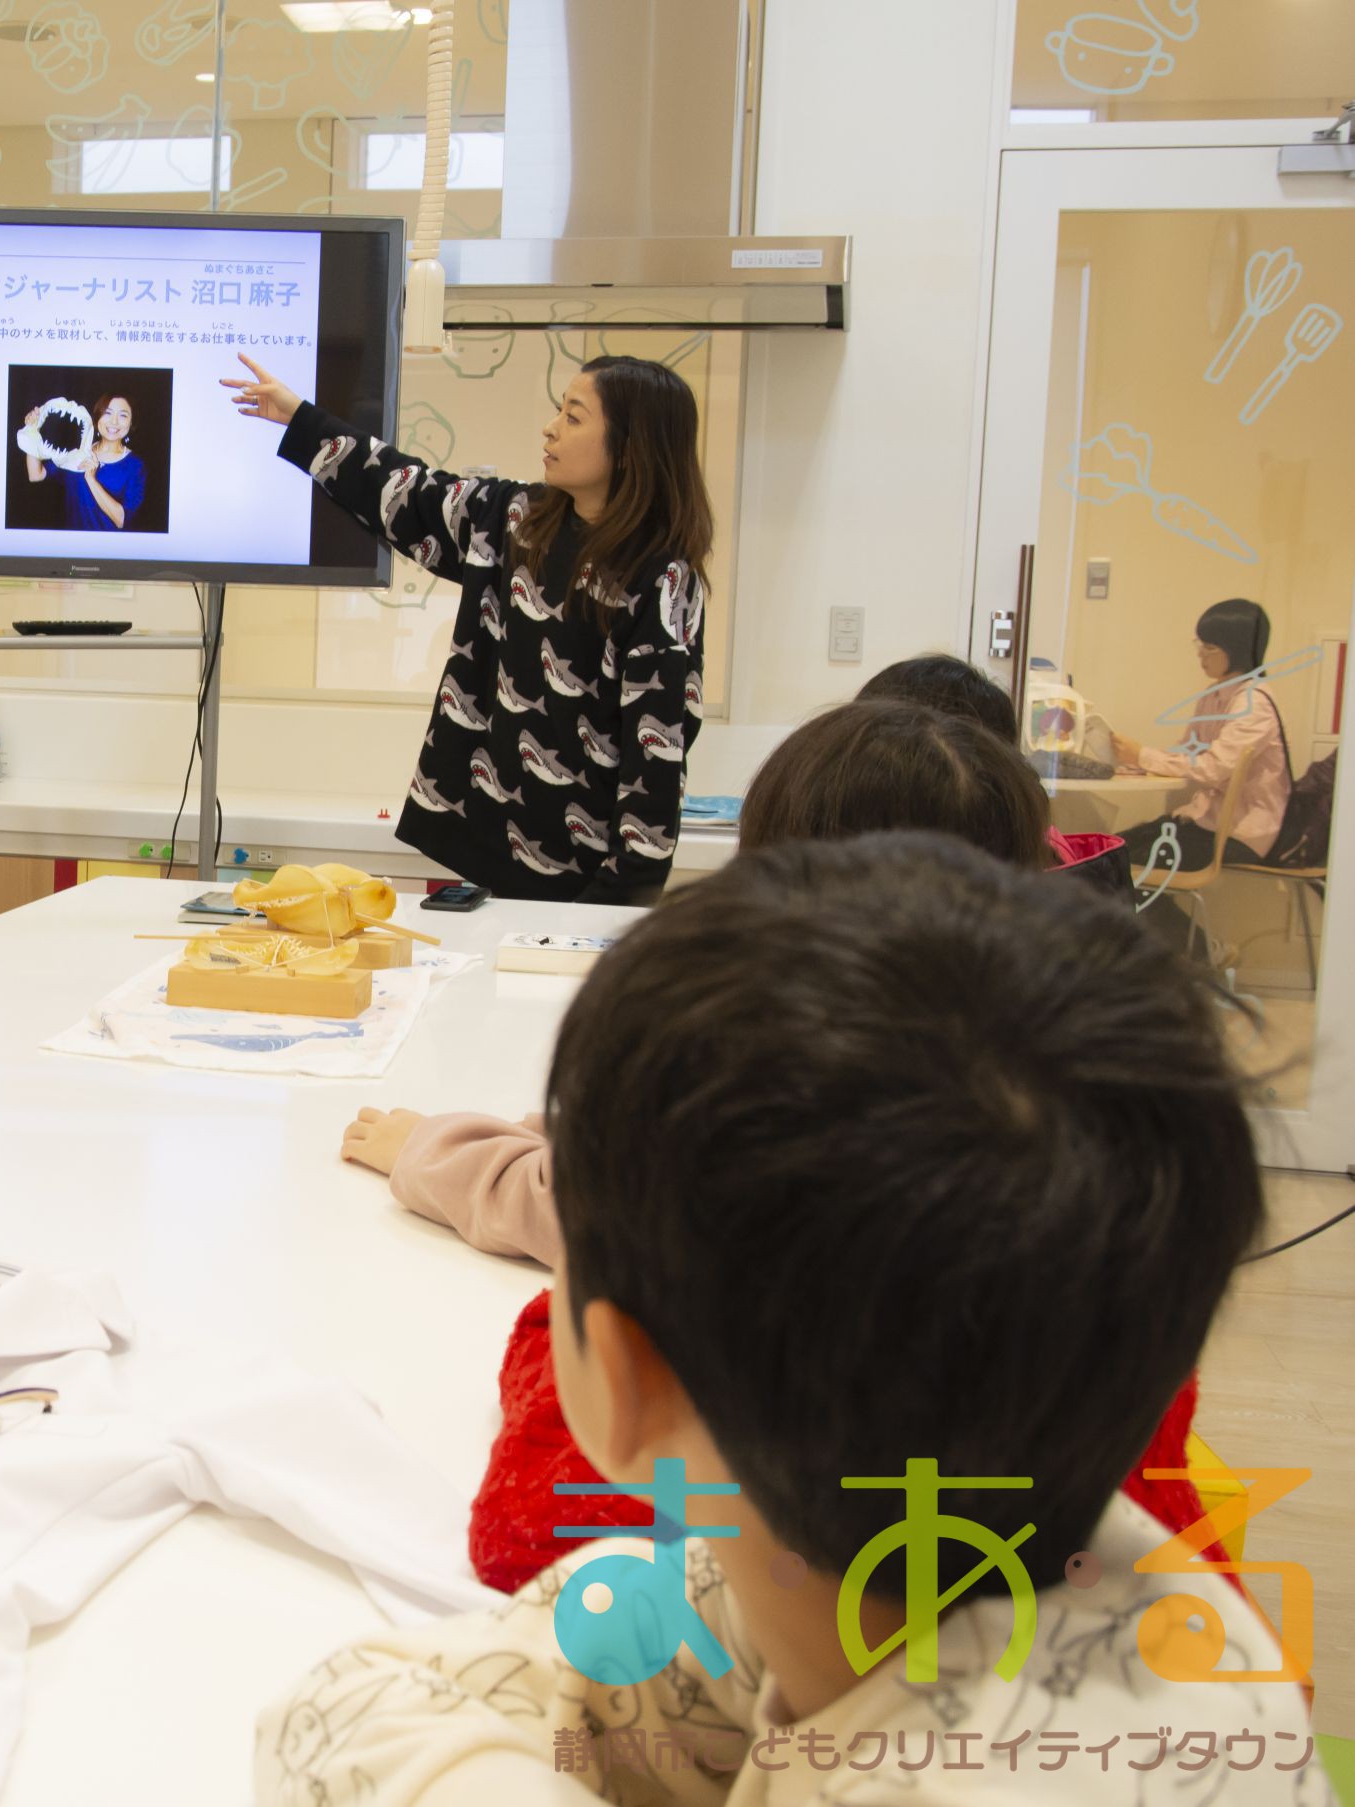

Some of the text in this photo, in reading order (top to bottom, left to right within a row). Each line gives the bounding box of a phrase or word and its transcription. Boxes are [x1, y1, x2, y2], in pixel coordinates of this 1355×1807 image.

[191, 279, 242, 306] 沼口
[248, 280, 301, 307] 麻子
[212, 321, 234, 330] しごと
